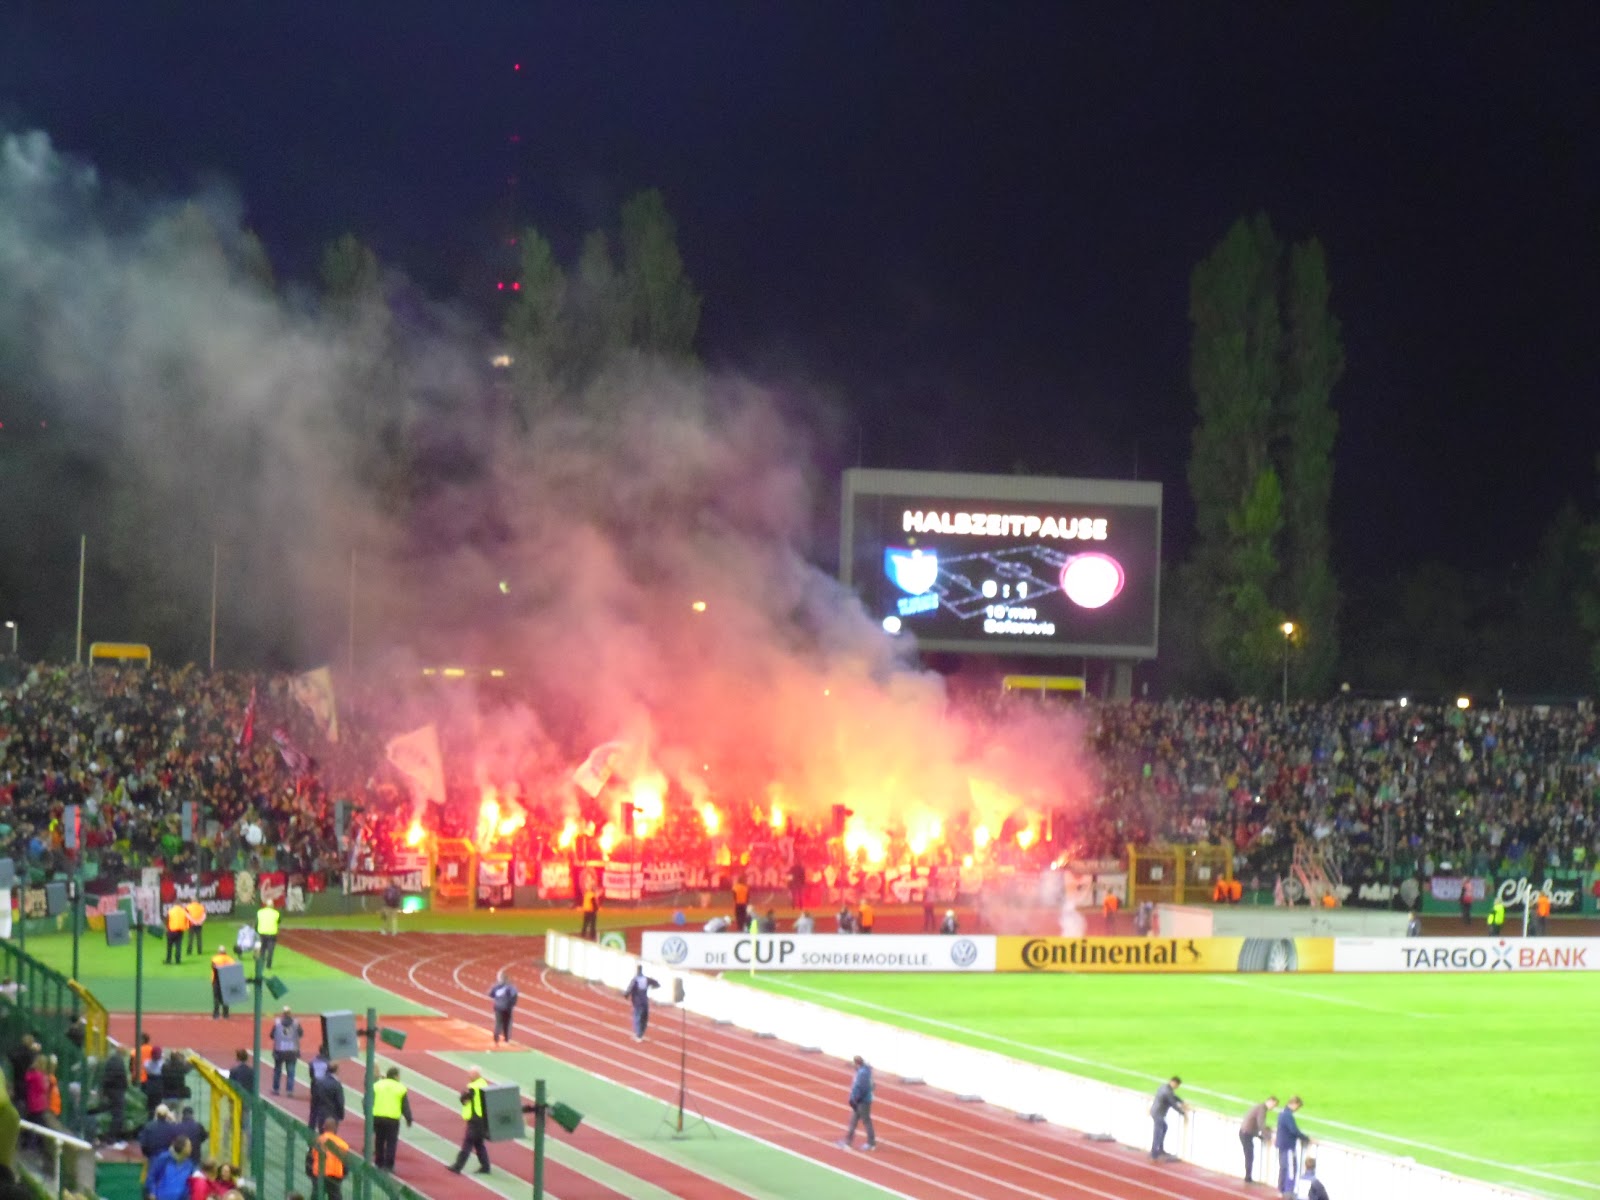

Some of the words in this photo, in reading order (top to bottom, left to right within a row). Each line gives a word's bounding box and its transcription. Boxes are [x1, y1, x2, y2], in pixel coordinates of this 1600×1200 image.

[902, 510, 1108, 541] HALBZEITPAUSE
[705, 952, 728, 964] DIE
[734, 939, 795, 964] CUP
[1021, 938, 1177, 969] Continental
[1519, 948, 1588, 968] BANK
